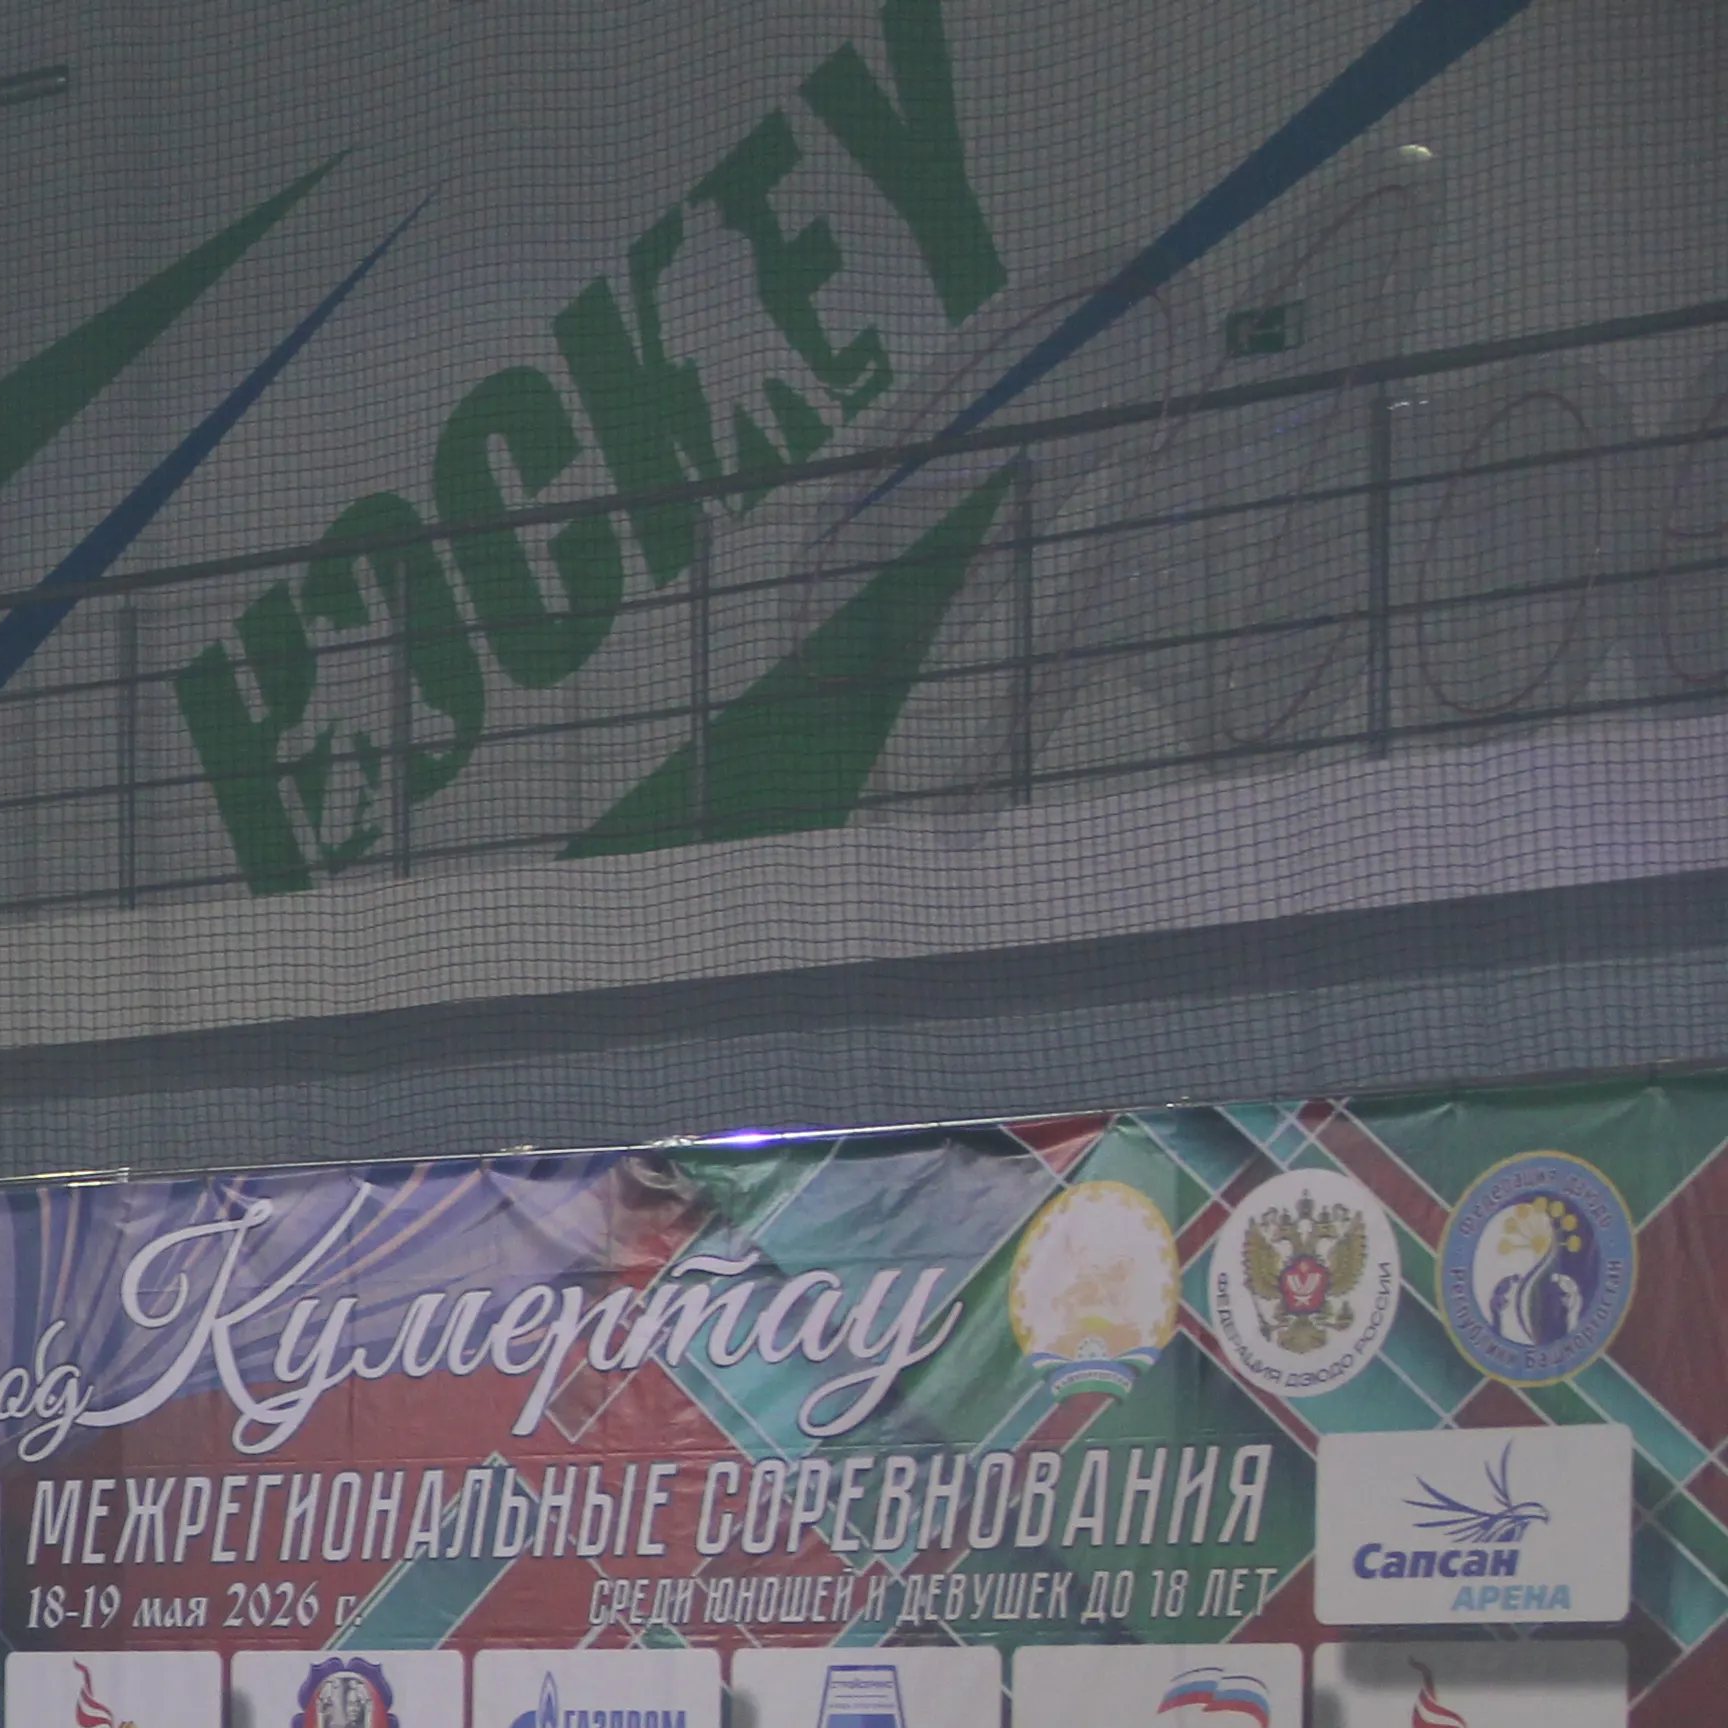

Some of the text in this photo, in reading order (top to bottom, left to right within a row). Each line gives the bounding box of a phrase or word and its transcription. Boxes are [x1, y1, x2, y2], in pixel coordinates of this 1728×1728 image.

[173, 0, 1008, 898] HOCKEY
[75, 1182, 962, 1455] Кумертау
[26, 1444, 1273, 1566] МЕЖРЕГИОНАЛЬНЫЕ СОРЕВНОВАНИЯ
[1352, 1543, 1520, 1580] Сапсан
[27, 1585, 121, 1630] 18-19
[133, 1594, 208, 1628] мая
[223, 1581, 321, 1628] 2026
[588, 1567, 1278, 1626] СРЕДИ ЮНОШЕЙ И ДЕВУШЕК ДО 18 ЛЕТ
[1450, 1584, 1572, 1611] АРЕНА
